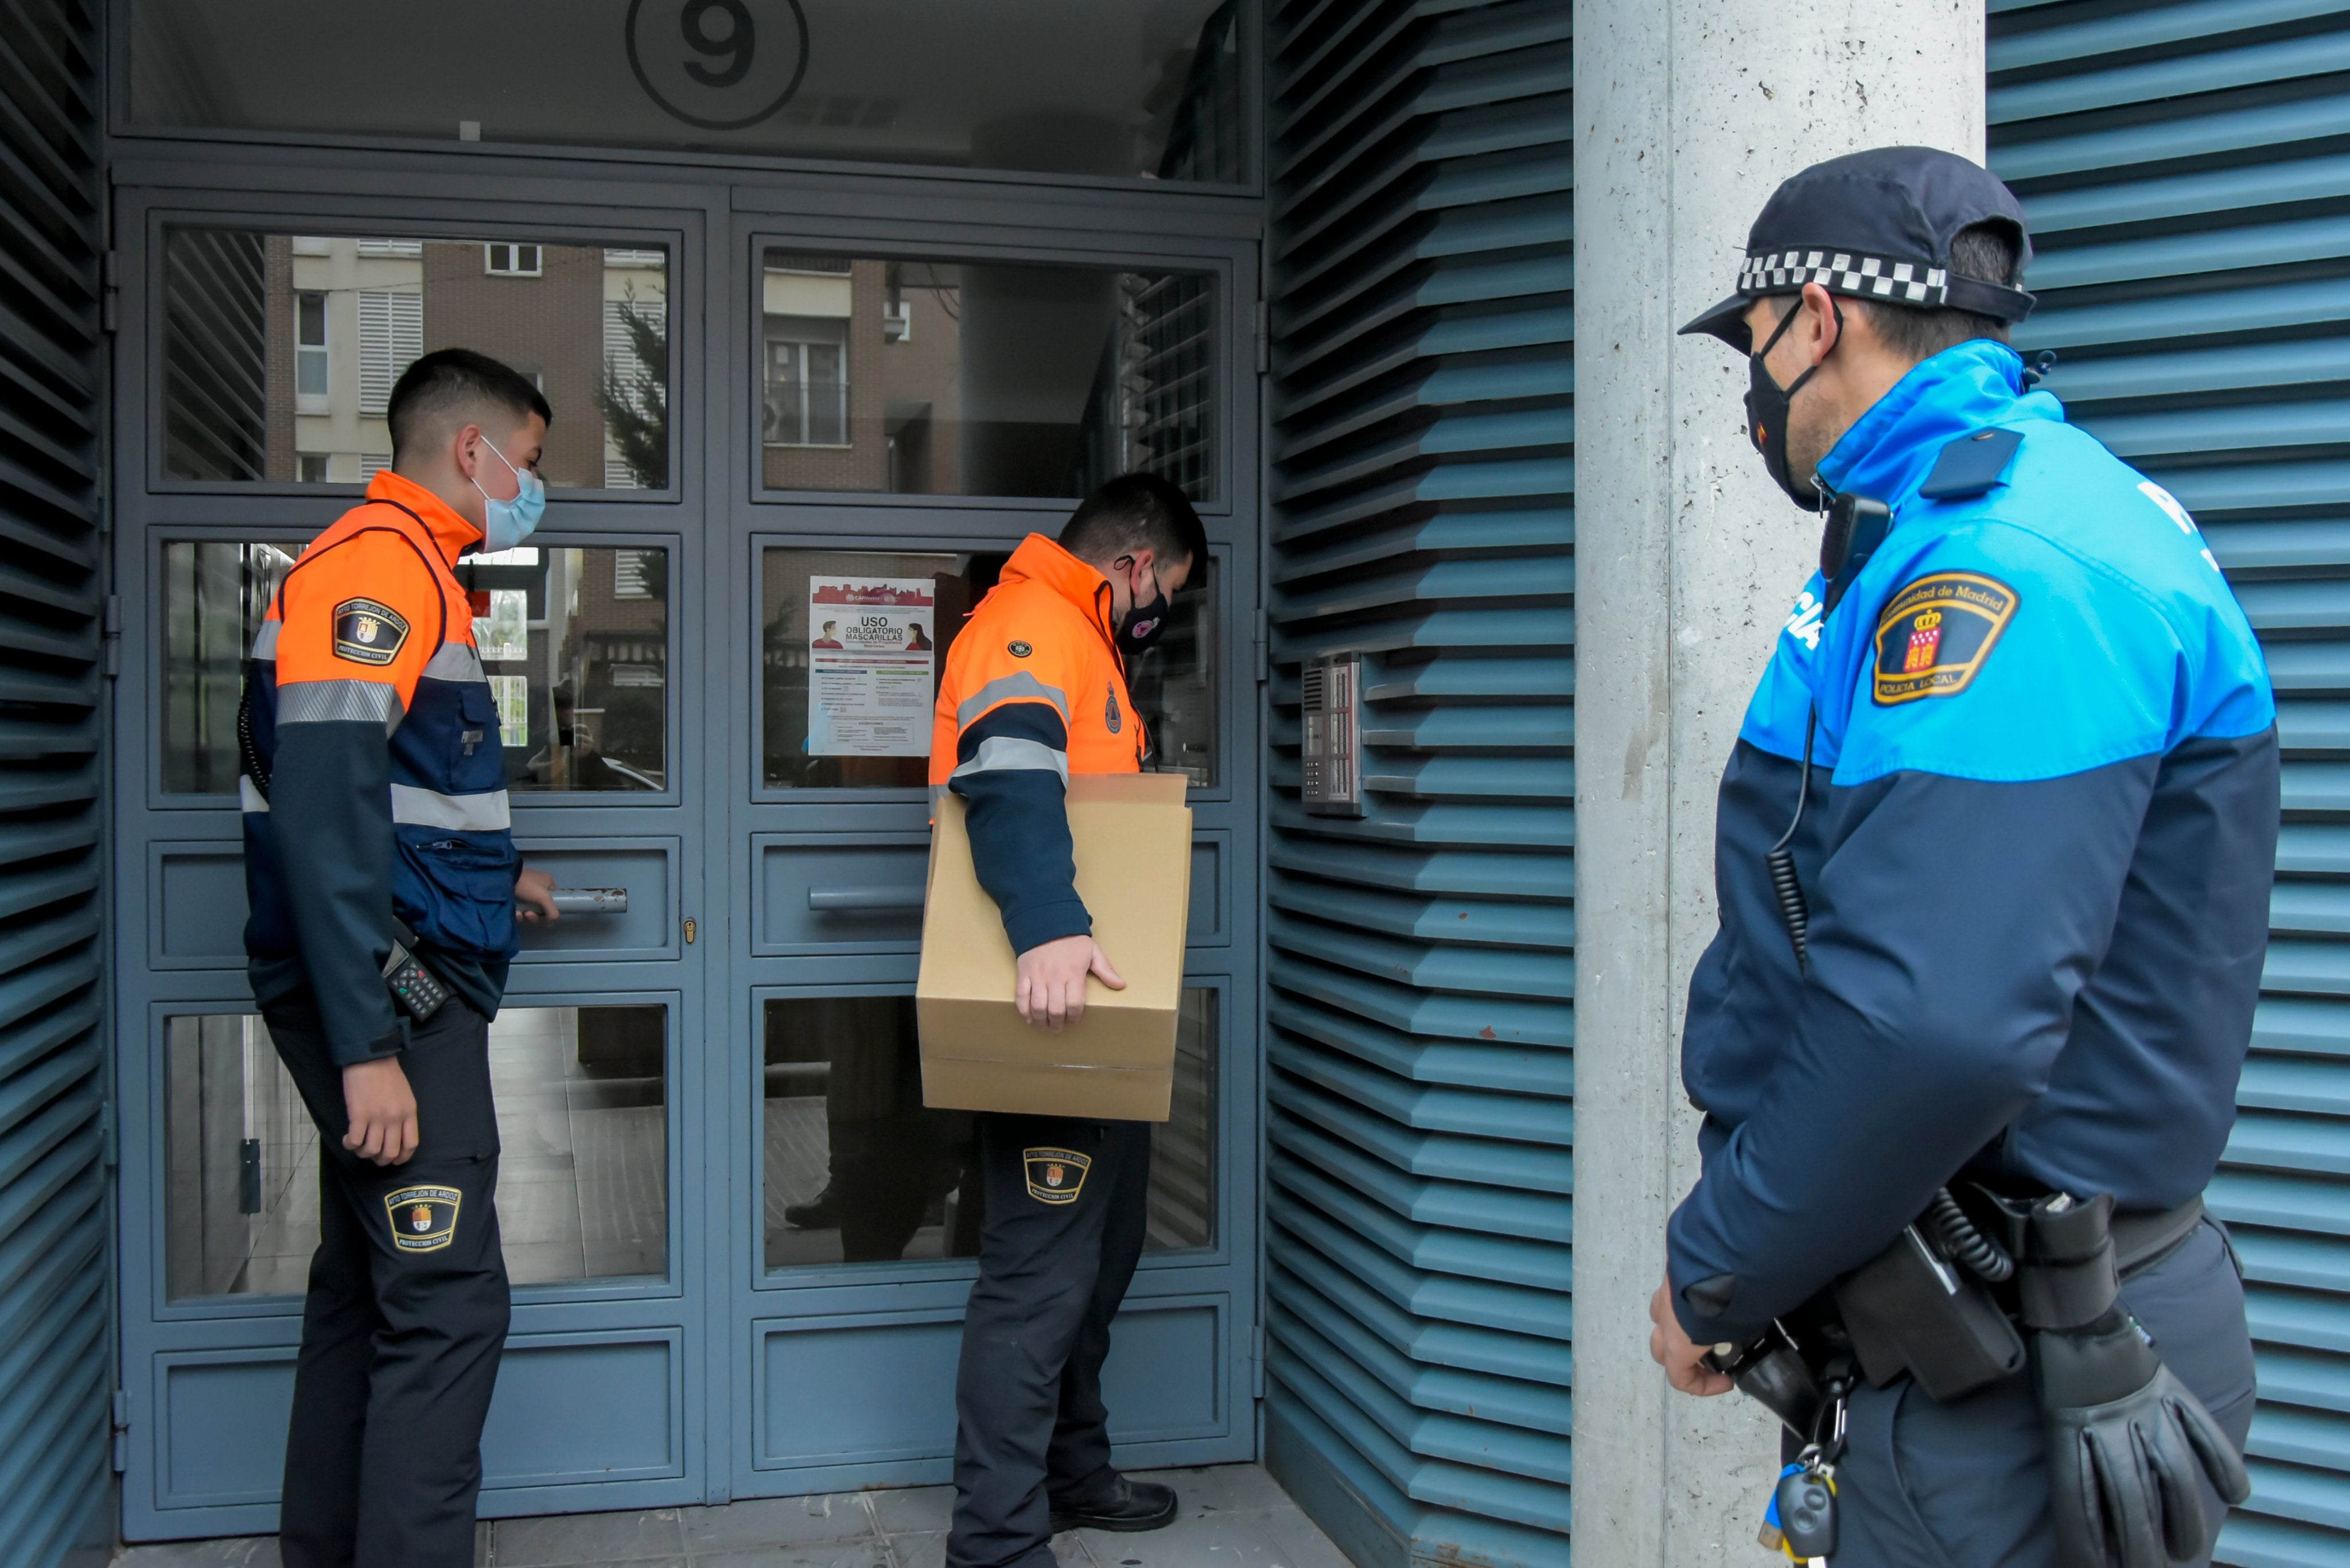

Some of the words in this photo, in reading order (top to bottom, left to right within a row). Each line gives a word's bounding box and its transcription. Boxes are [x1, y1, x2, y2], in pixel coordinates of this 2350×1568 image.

[680, 0, 756, 88] 9
[1885, 586, 1935, 619] omunidad
[1937, 585, 1953, 597] de
[1955, 585, 2004, 610] Madrid
[380, 610, 390, 618] DE
[389, 614, 407, 630] ARDOZ
[861, 616, 888, 627] USO
[846, 627, 903, 635] OBLIGATORIO
[1920, 674, 1956, 688] LOCAL
[1072, 1155, 1089, 1165] ARDOZ
[438, 1190, 458, 1200] ARDOZ
[1031, 1188, 1060, 1200] PROTECCION
[399, 1239, 431, 1247] PROTECCION
[432, 1235, 448, 1244] CIVIL
